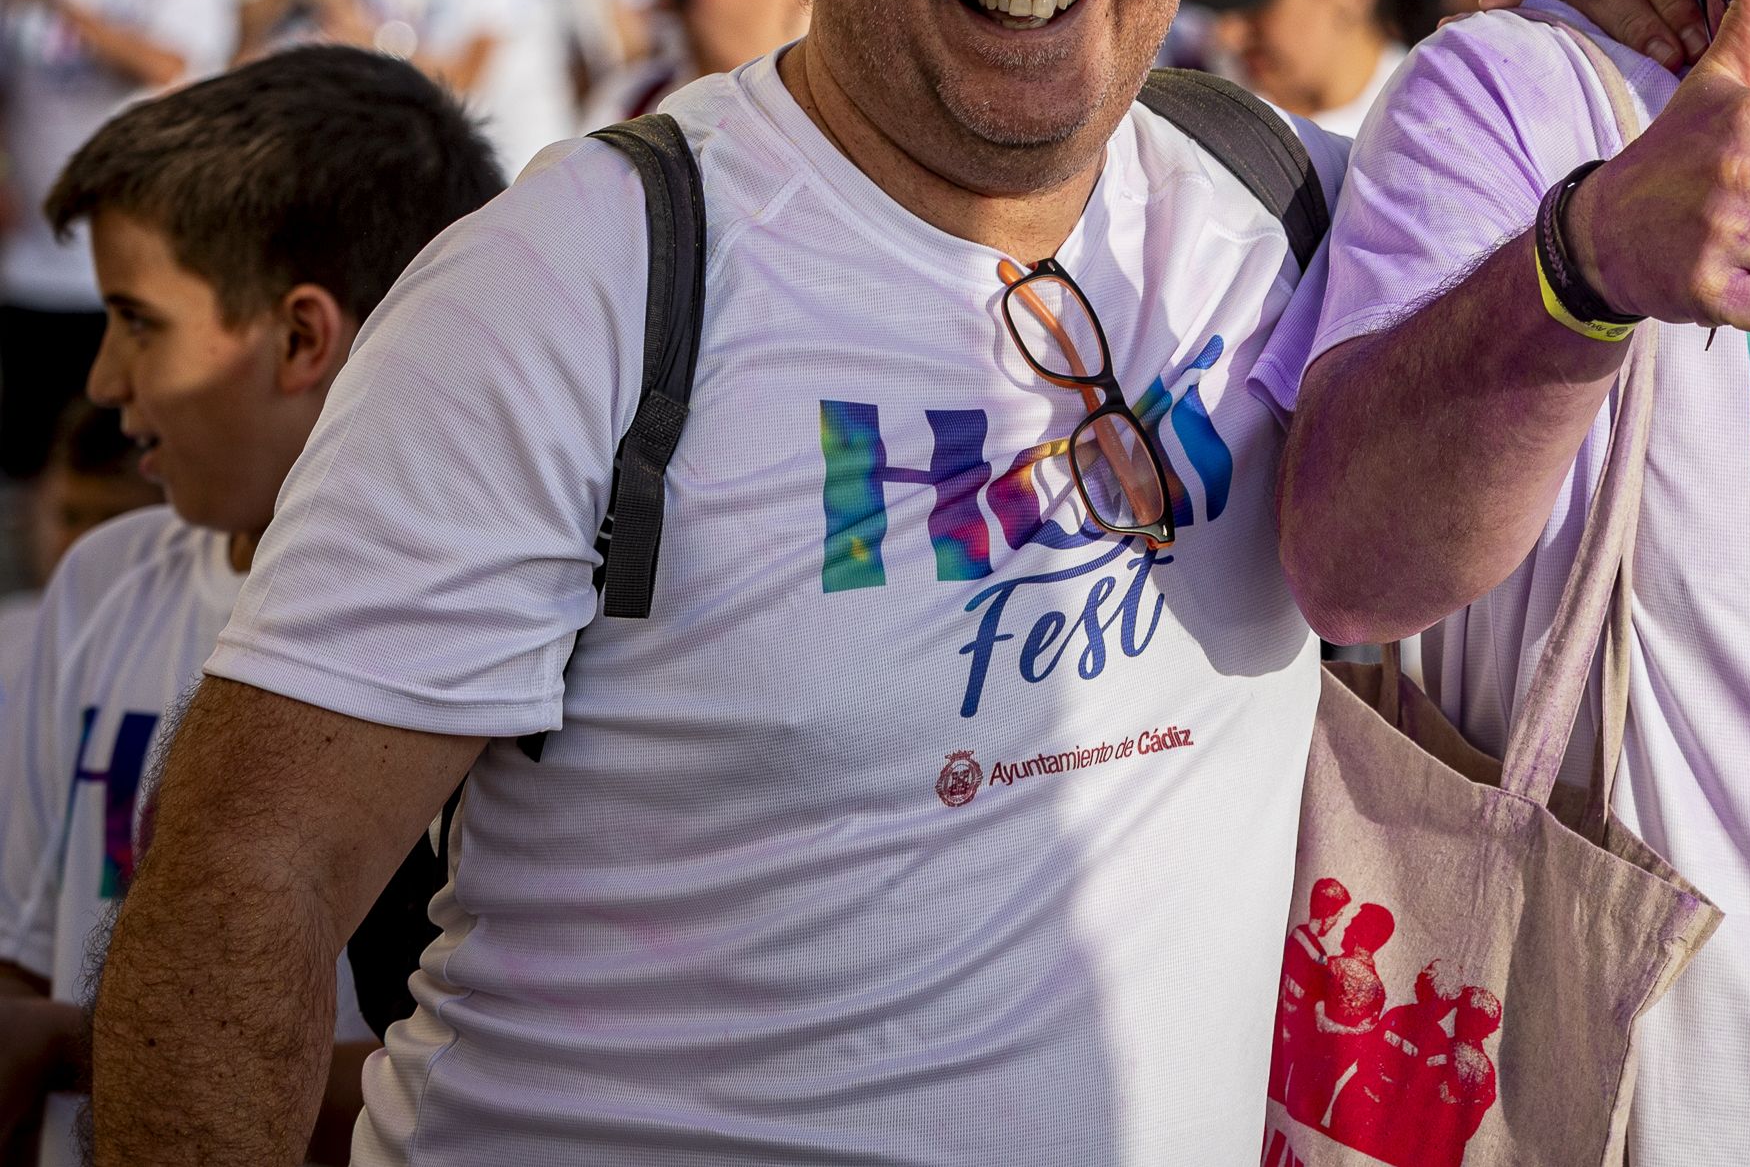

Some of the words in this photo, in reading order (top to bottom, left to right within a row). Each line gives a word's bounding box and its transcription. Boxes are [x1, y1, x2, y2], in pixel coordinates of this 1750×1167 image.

[959, 537, 1174, 718] Fest
[989, 741, 1113, 786] Ayuntamiento
[1115, 736, 1135, 759] de
[1137, 725, 1195, 756] Cádiz
